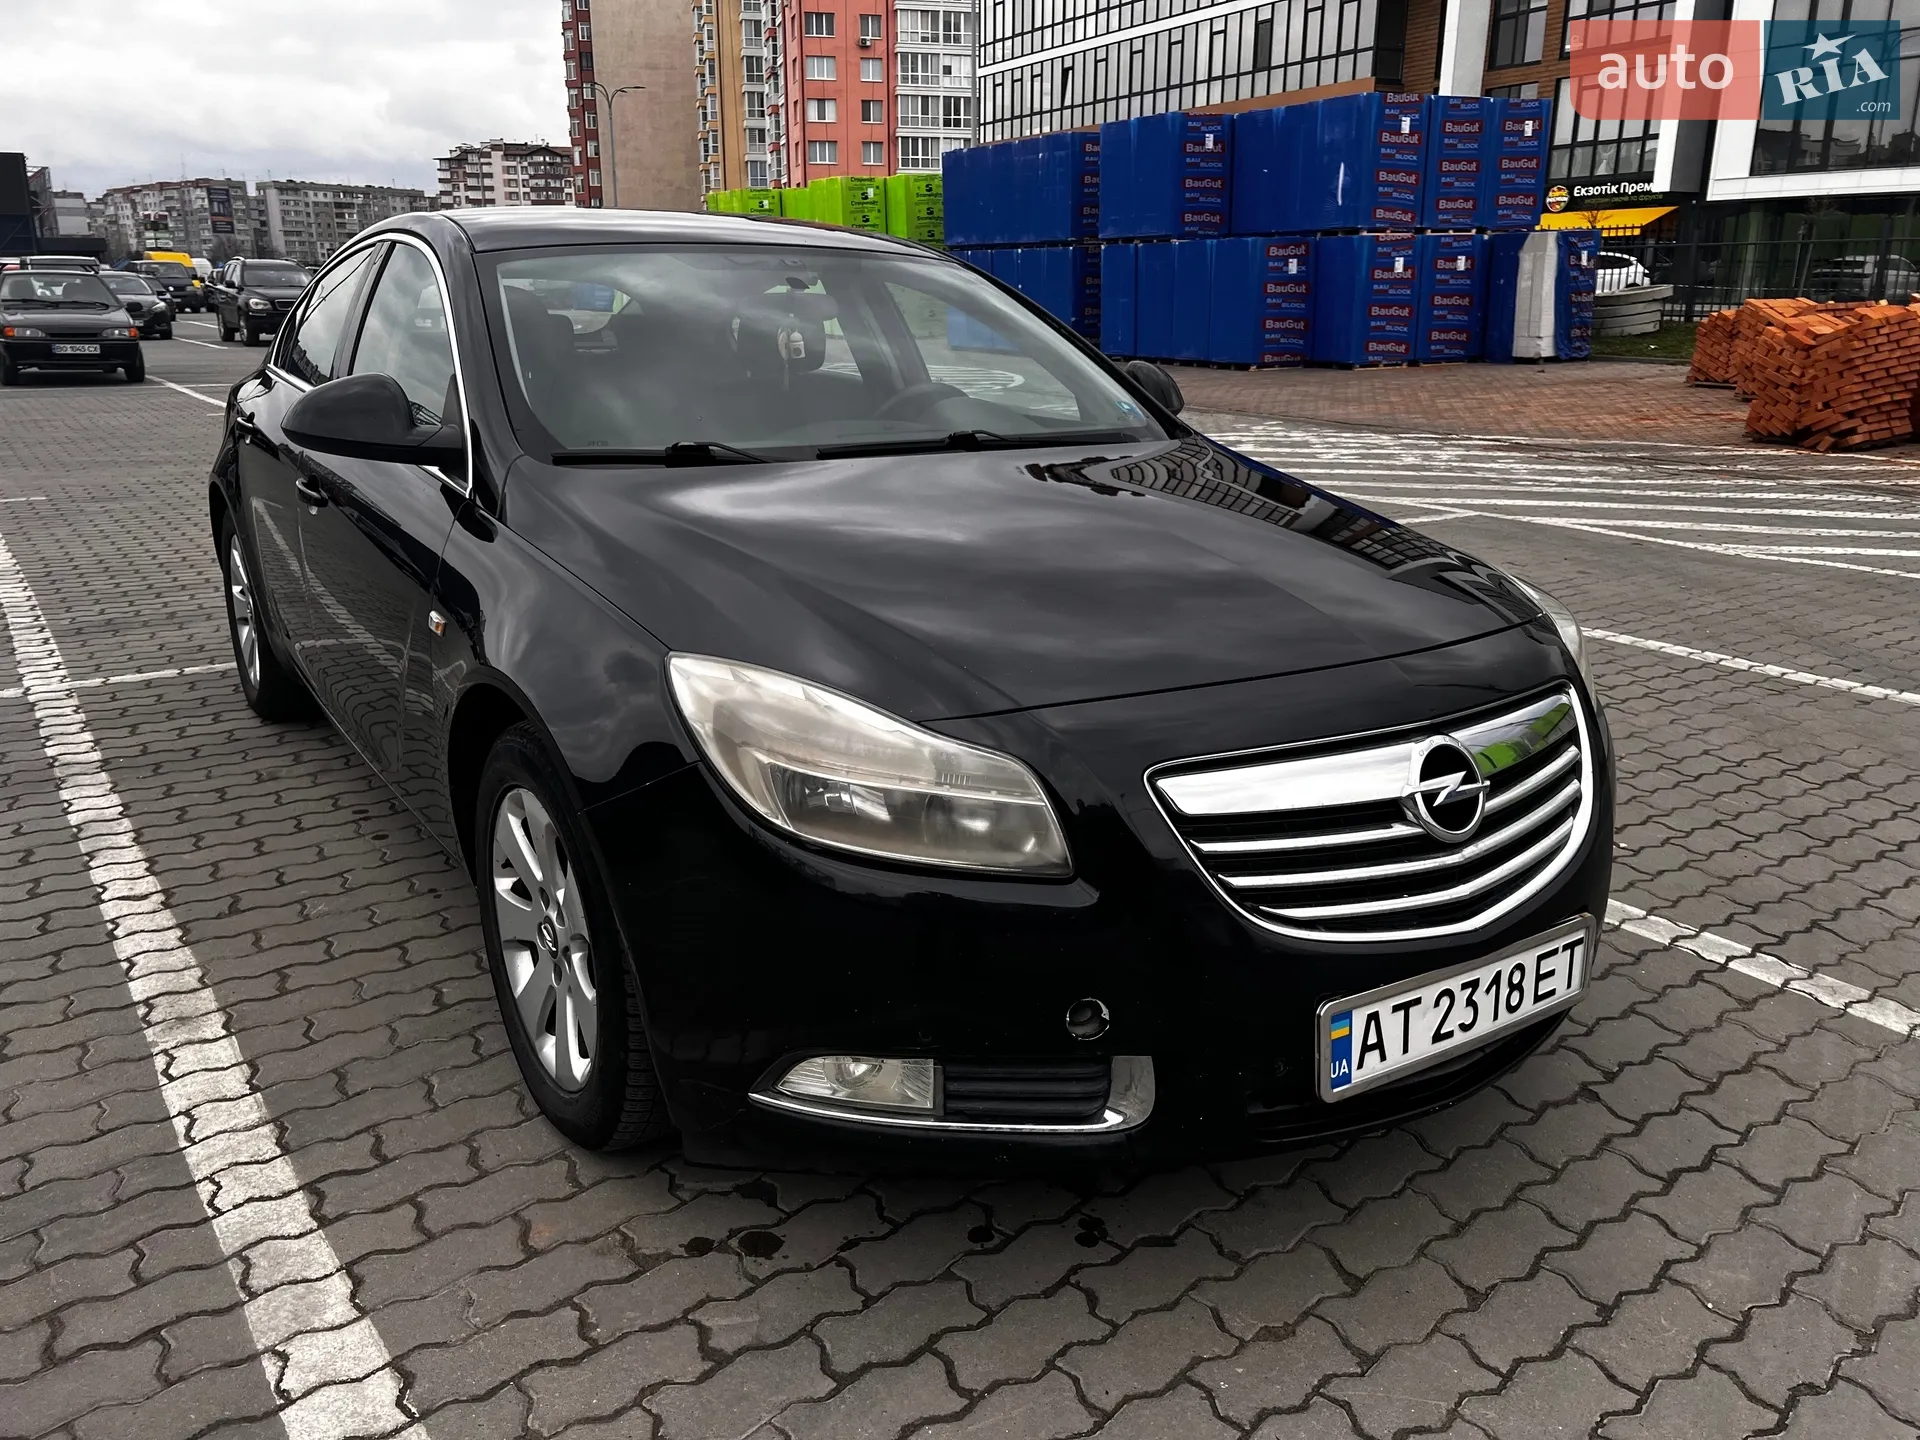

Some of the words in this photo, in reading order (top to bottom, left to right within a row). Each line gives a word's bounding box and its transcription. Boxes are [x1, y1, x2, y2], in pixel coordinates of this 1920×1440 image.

[1387, 92, 1420, 103] BauGut
[1446, 122, 1480, 132] BauGut
[1505, 120, 1540, 131] Bauut
[1382, 132, 1419, 144] BauGut
[1442, 161, 1477, 171] BauGut
[1501, 159, 1537, 169] BauGut
[1379, 171, 1417, 184] BauGut
[1185, 179, 1222, 189] BauGut
[1573, 183, 1619, 197] Екзотік
[1439, 200, 1474, 209] BauGut
[1498, 196, 1534, 206] BauGut
[1184, 213, 1221, 223] BauGut
[1376, 209, 1412, 222] BauGut
[1269, 244, 1307, 256] BauGut
[1437, 259, 1472, 269] Bauut
[1374, 269, 1412, 279] BauGut
[1267, 283, 1307, 293] BauGut
[1434, 295, 1470, 306] BauGut
[1371, 306, 1410, 317] BauGut
[1265, 319, 1305, 330] BauGut
[1431, 331, 1468, 342] BauGut
[1368, 342, 1406, 354] BauGut
[1356, 996, 1422, 1071] AT
[1431, 962, 1526, 1045] 2318
[1532, 936, 1585, 1005] ET
[1330, 1058, 1349, 1079] UA
